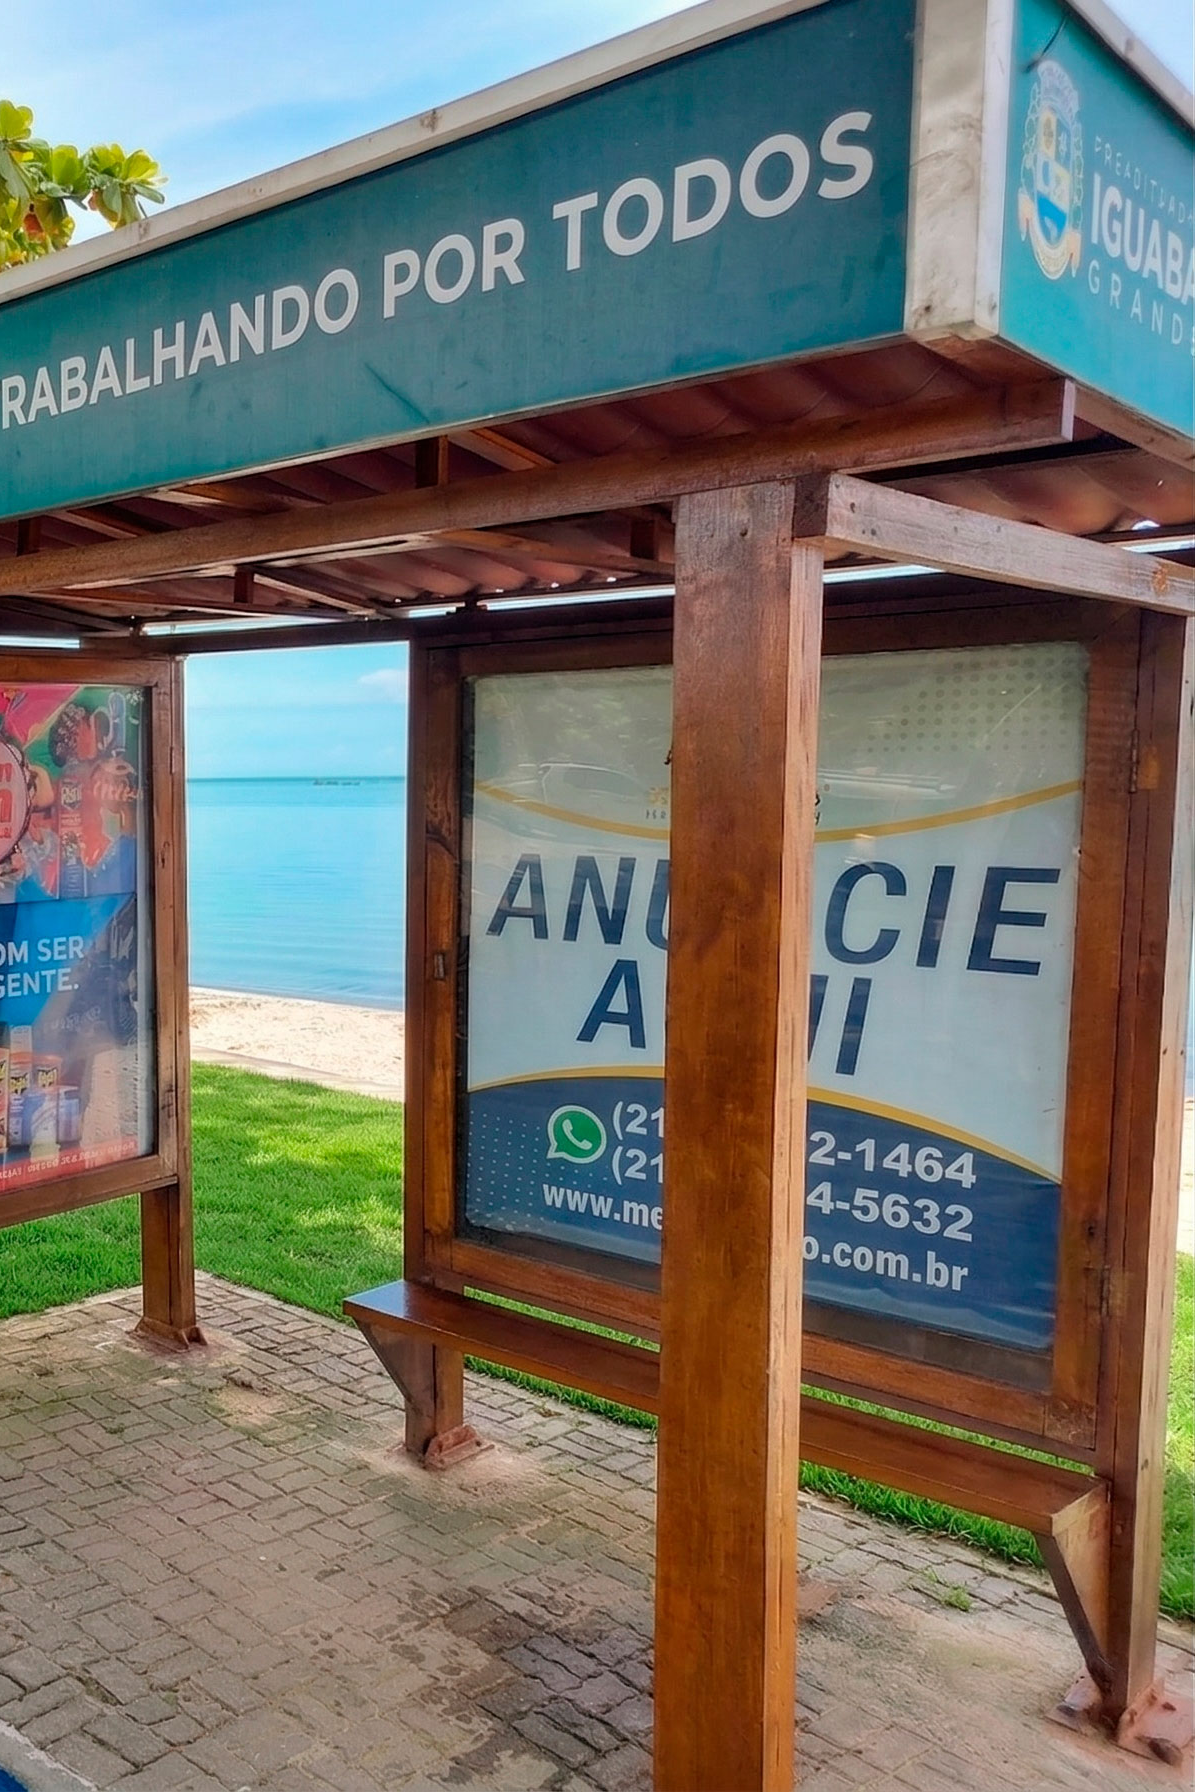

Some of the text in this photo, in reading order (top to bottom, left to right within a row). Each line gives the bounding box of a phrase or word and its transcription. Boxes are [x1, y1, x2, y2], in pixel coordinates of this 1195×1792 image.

[382, 218, 526, 319] POR
[553, 111, 874, 273] TODOS
[1091, 171, 1195, 305] IGUABA
[1088, 259, 1195, 356] GRAND
[38, 935, 85, 961] SER
[487, 853, 1062, 976] ANCIE
[611, 1145, 973, 1242] (21 4-5632
[612, 1101, 977, 1189] (21 2-1464
